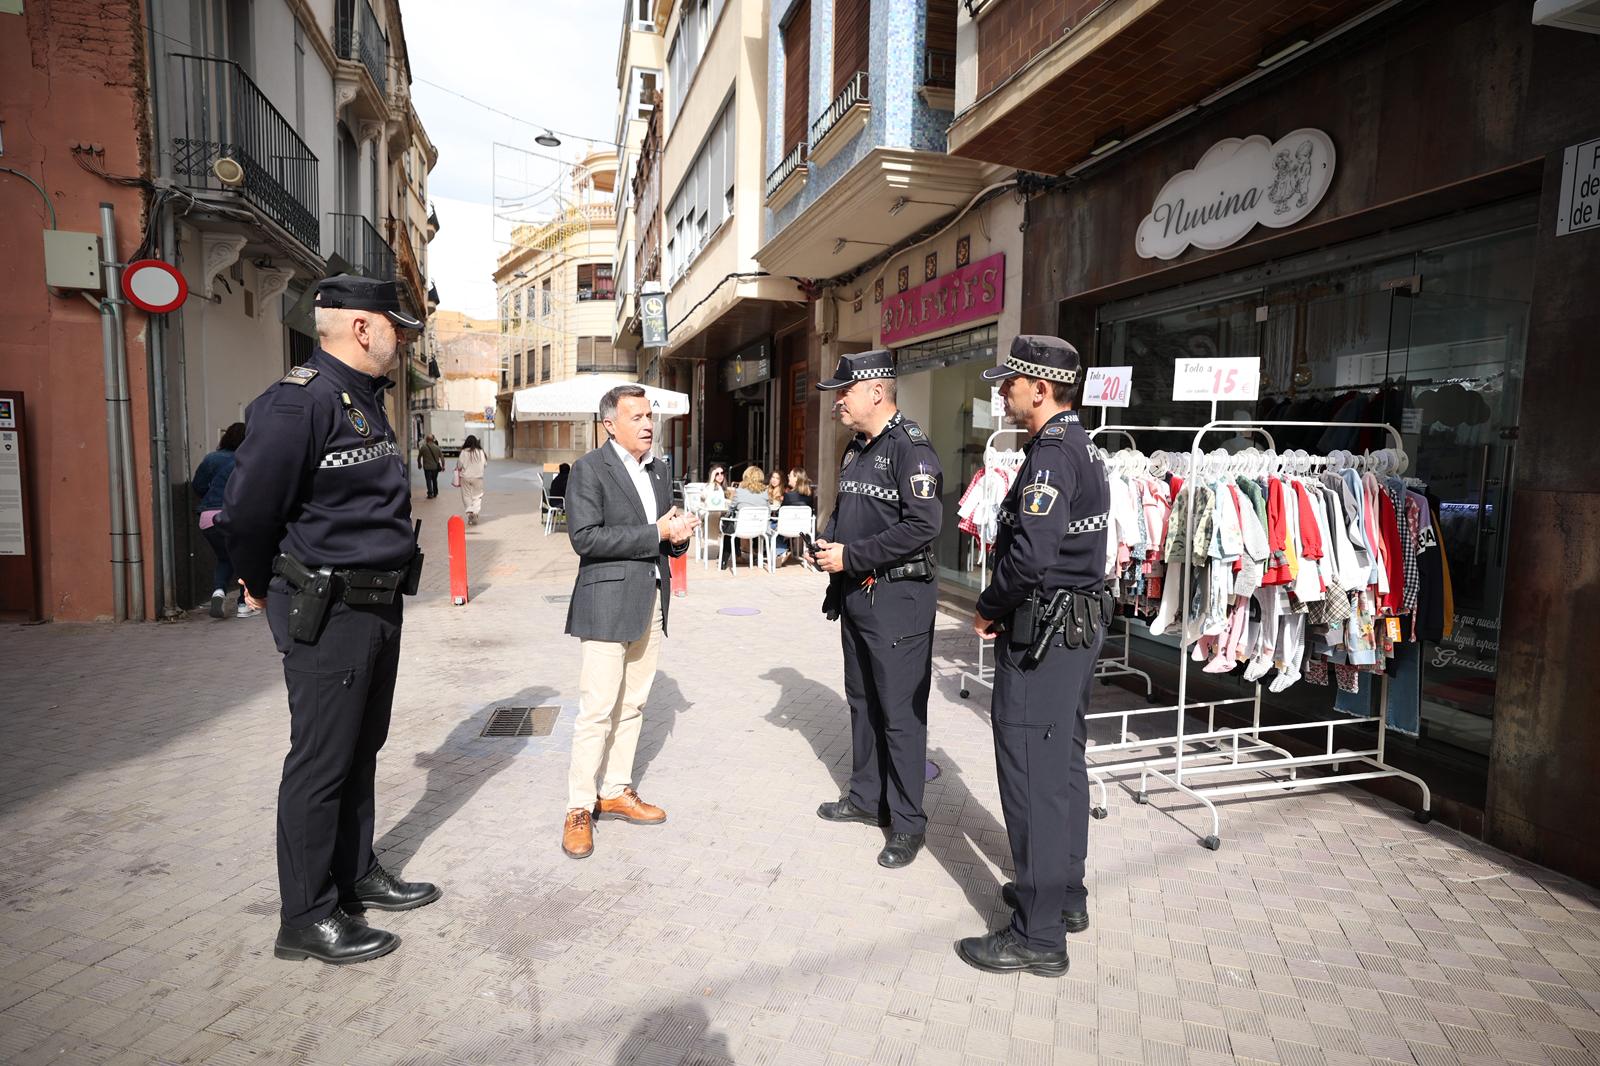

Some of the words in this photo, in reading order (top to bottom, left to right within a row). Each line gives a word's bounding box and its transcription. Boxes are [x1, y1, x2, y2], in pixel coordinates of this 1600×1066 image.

[1581, 174, 1600, 198] de
[1153, 187, 1264, 238] Nuvina
[1573, 202, 1592, 225] de
[1184, 363, 1204, 373] Todo
[1101, 376, 1121, 400] 20
[1212, 368, 1239, 394] 15
